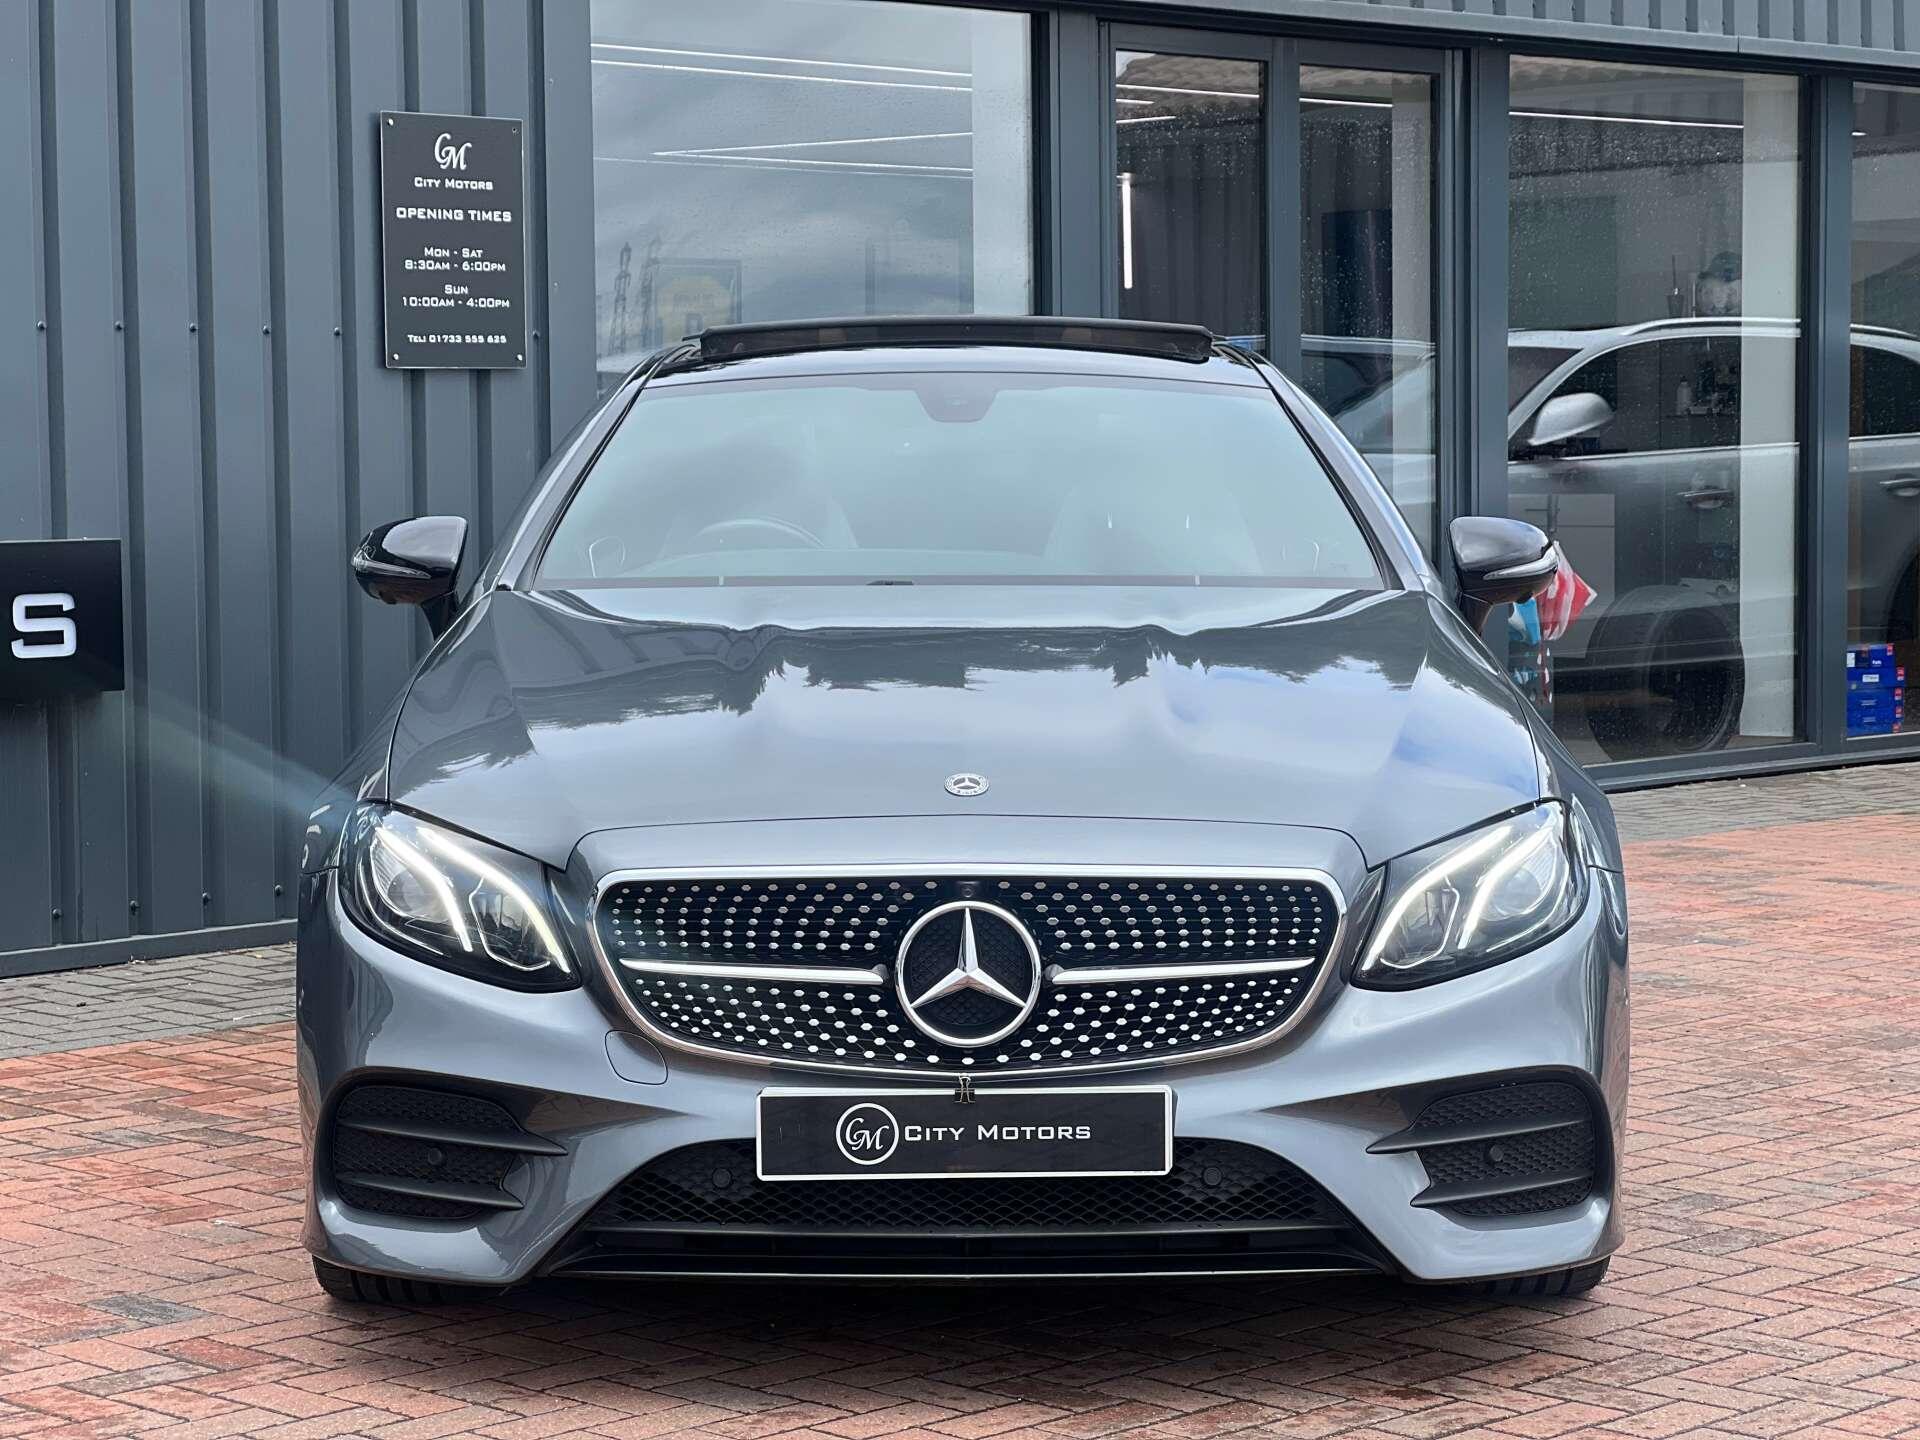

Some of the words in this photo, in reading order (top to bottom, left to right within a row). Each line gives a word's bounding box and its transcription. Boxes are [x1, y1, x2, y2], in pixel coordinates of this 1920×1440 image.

[396, 207, 464, 221] OPENING
[467, 209, 512, 223] TIMES
[424, 246, 450, 258] MON
[461, 247, 484, 259] SAT
[404, 259, 451, 271] 8:30AM
[462, 260, 506, 272] 6:00PM
[444, 284, 469, 295] SUN
[402, 296, 455, 308] 10:00AM
[466, 297, 510, 309] 4:00PM
[11, 592, 77, 659] S
[904, 1124, 965, 1142] CITY
[977, 1124, 1092, 1141] MOTORS
